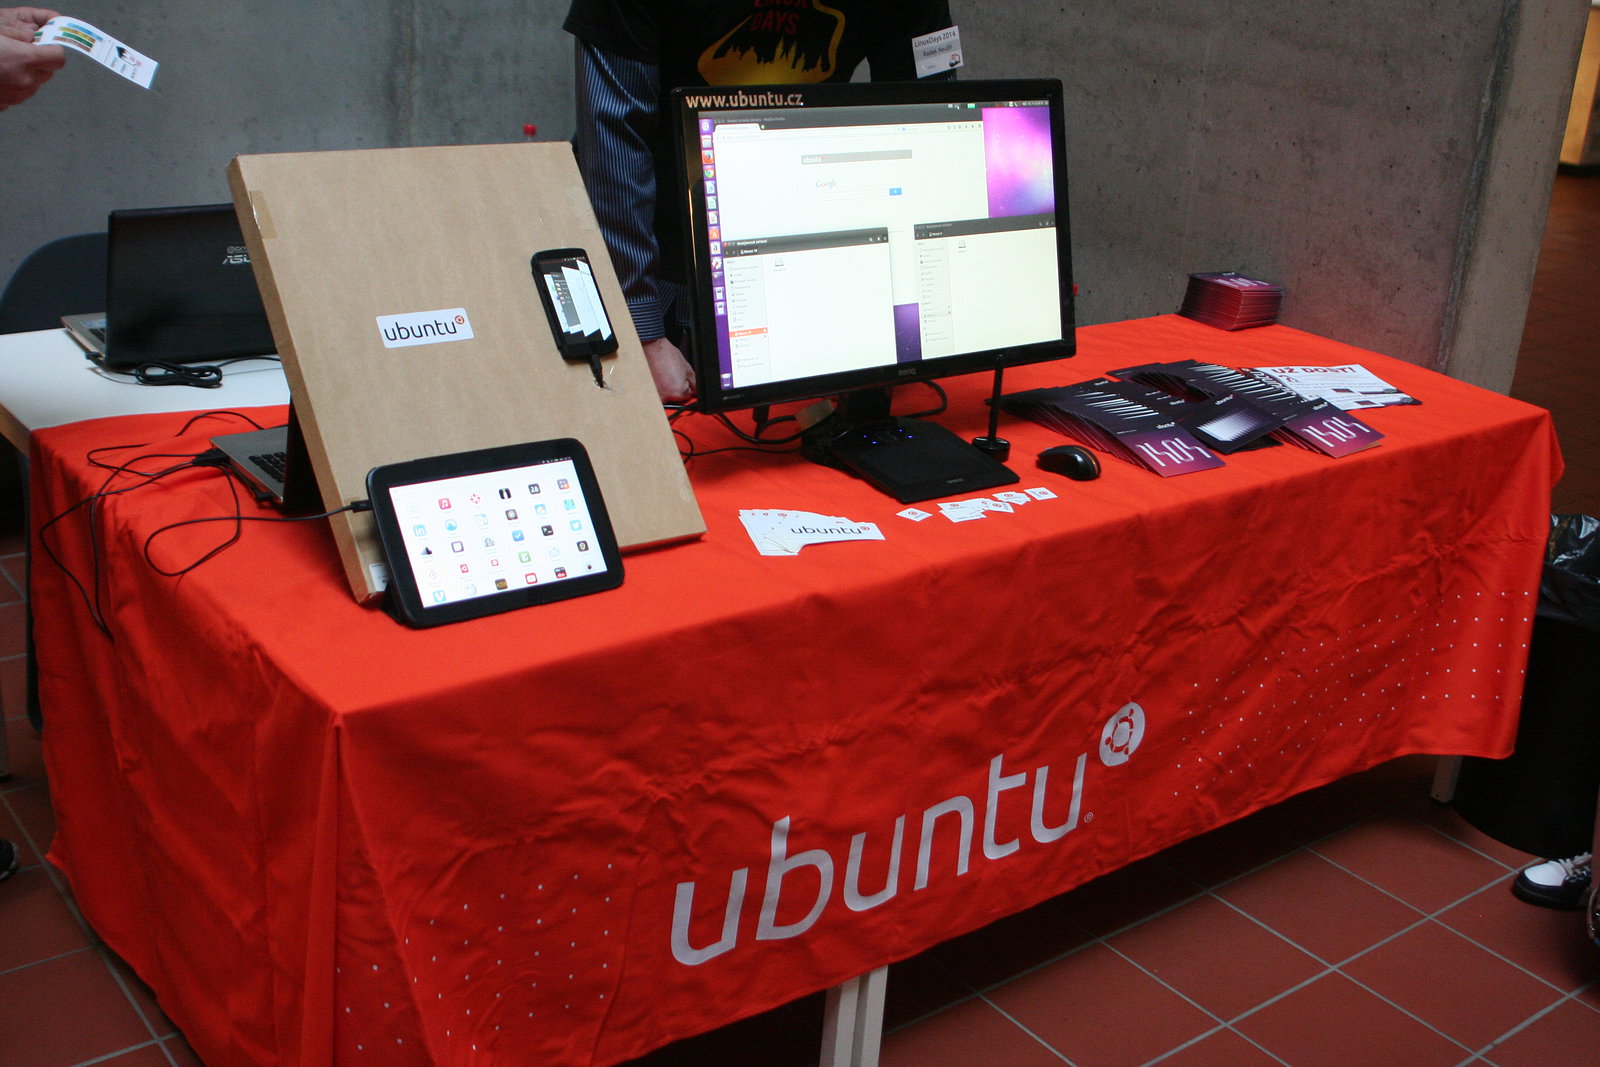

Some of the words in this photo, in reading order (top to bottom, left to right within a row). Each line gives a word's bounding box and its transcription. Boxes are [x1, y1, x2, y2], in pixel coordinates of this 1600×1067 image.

[750, 10, 799, 34] DAYS
[914, 36, 942, 48] LinuxDays
[942, 30, 956, 40] 2014
[685, 90, 802, 108] www.ubuntu.cz
[384, 320, 457, 341] ubuntu
[790, 525, 862, 535] ubuntu
[670, 752, 1088, 967] ubuntu
